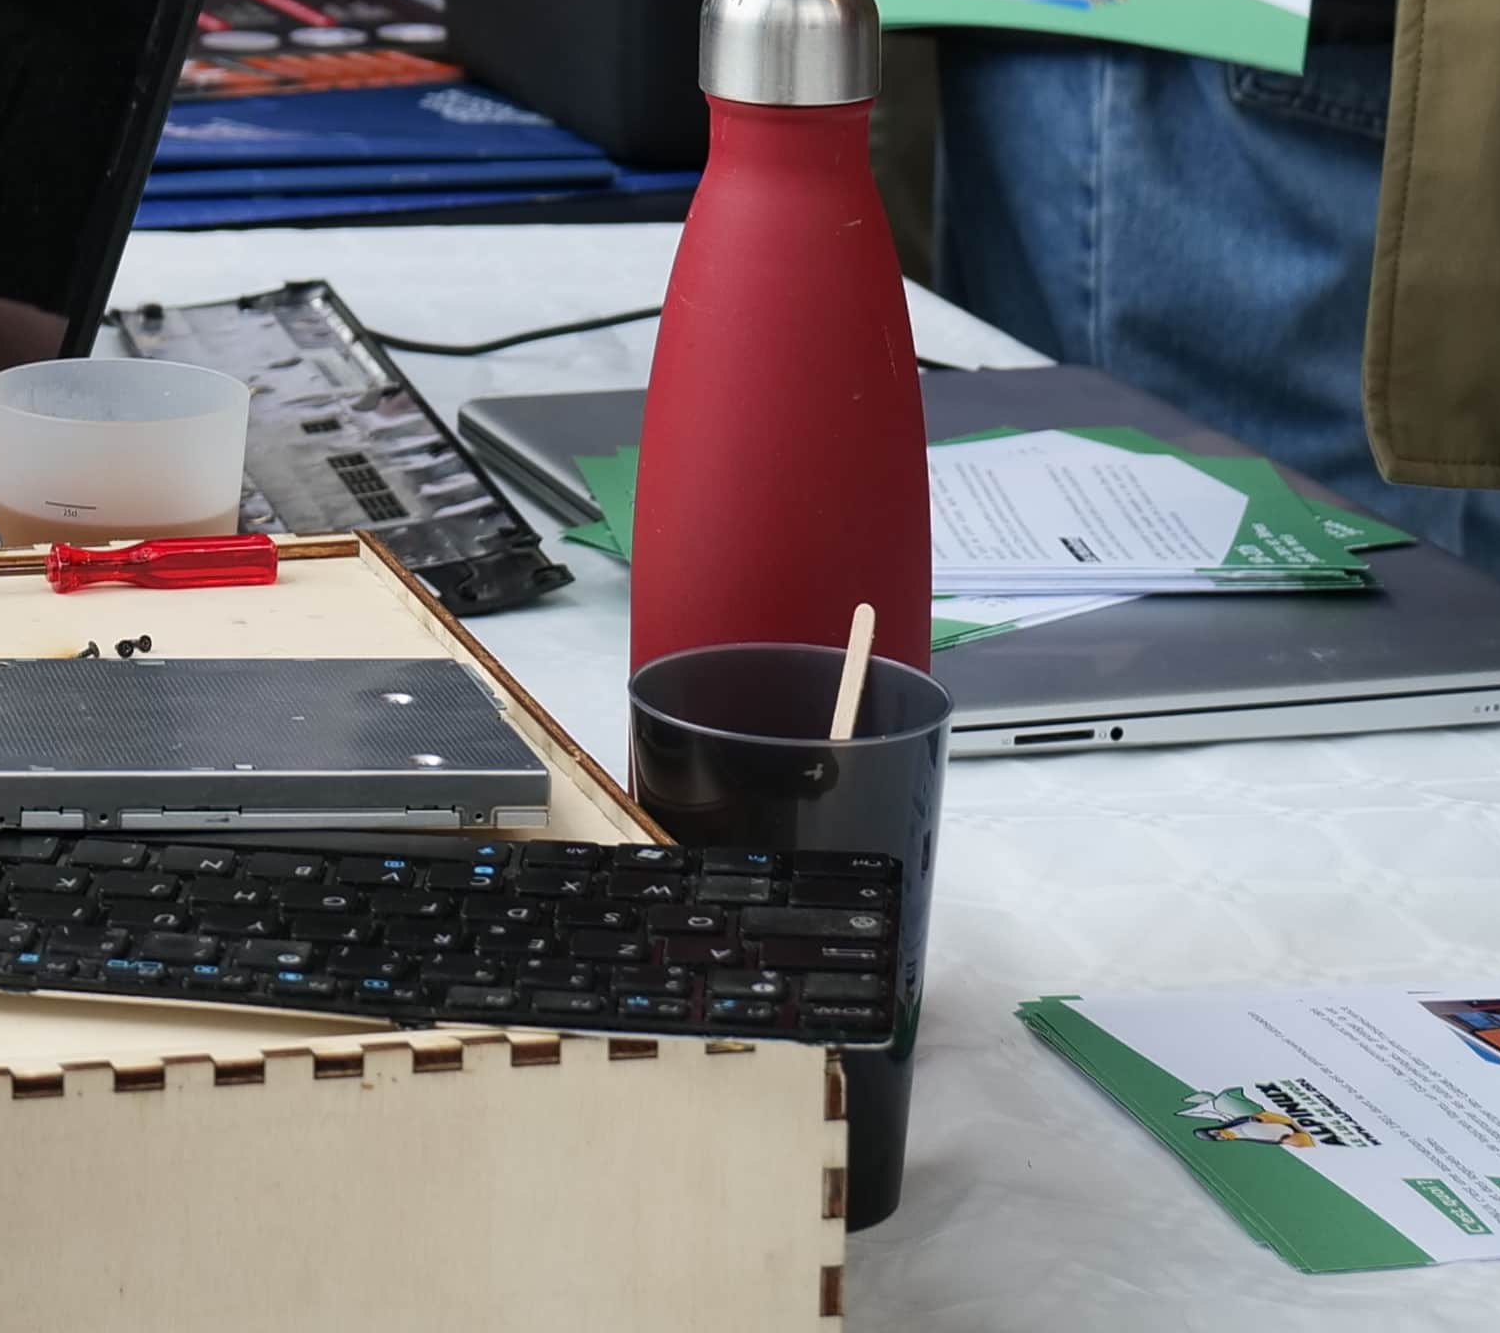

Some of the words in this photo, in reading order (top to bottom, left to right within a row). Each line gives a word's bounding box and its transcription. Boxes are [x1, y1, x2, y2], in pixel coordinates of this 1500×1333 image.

[199, 859, 223, 870] N
[56, 876, 77, 888] K
[381, 872, 400, 882] V
[561, 880, 581, 891] X
[643, 884, 671, 896] W
[233, 890, 257, 901] H
[323, 895, 347, 907] G
[506, 907, 528, 919] D
[603, 912, 621, 924] S
[153, 914, 177, 925] U
[247, 920, 264, 931] Y
[687, 915, 713, 927] Q
[433, 933, 451, 944] R
[527, 938, 545, 950] E
[618, 943, 636, 955] Z
[710, 948, 731, 959] A
[1255, 1082, 1351, 1147] ALPINUX
[1416, 1180, 1430, 1188] ?
[1430, 1187, 1458, 1211] quoi
[1453, 1210, 1485, 1233] C'est
